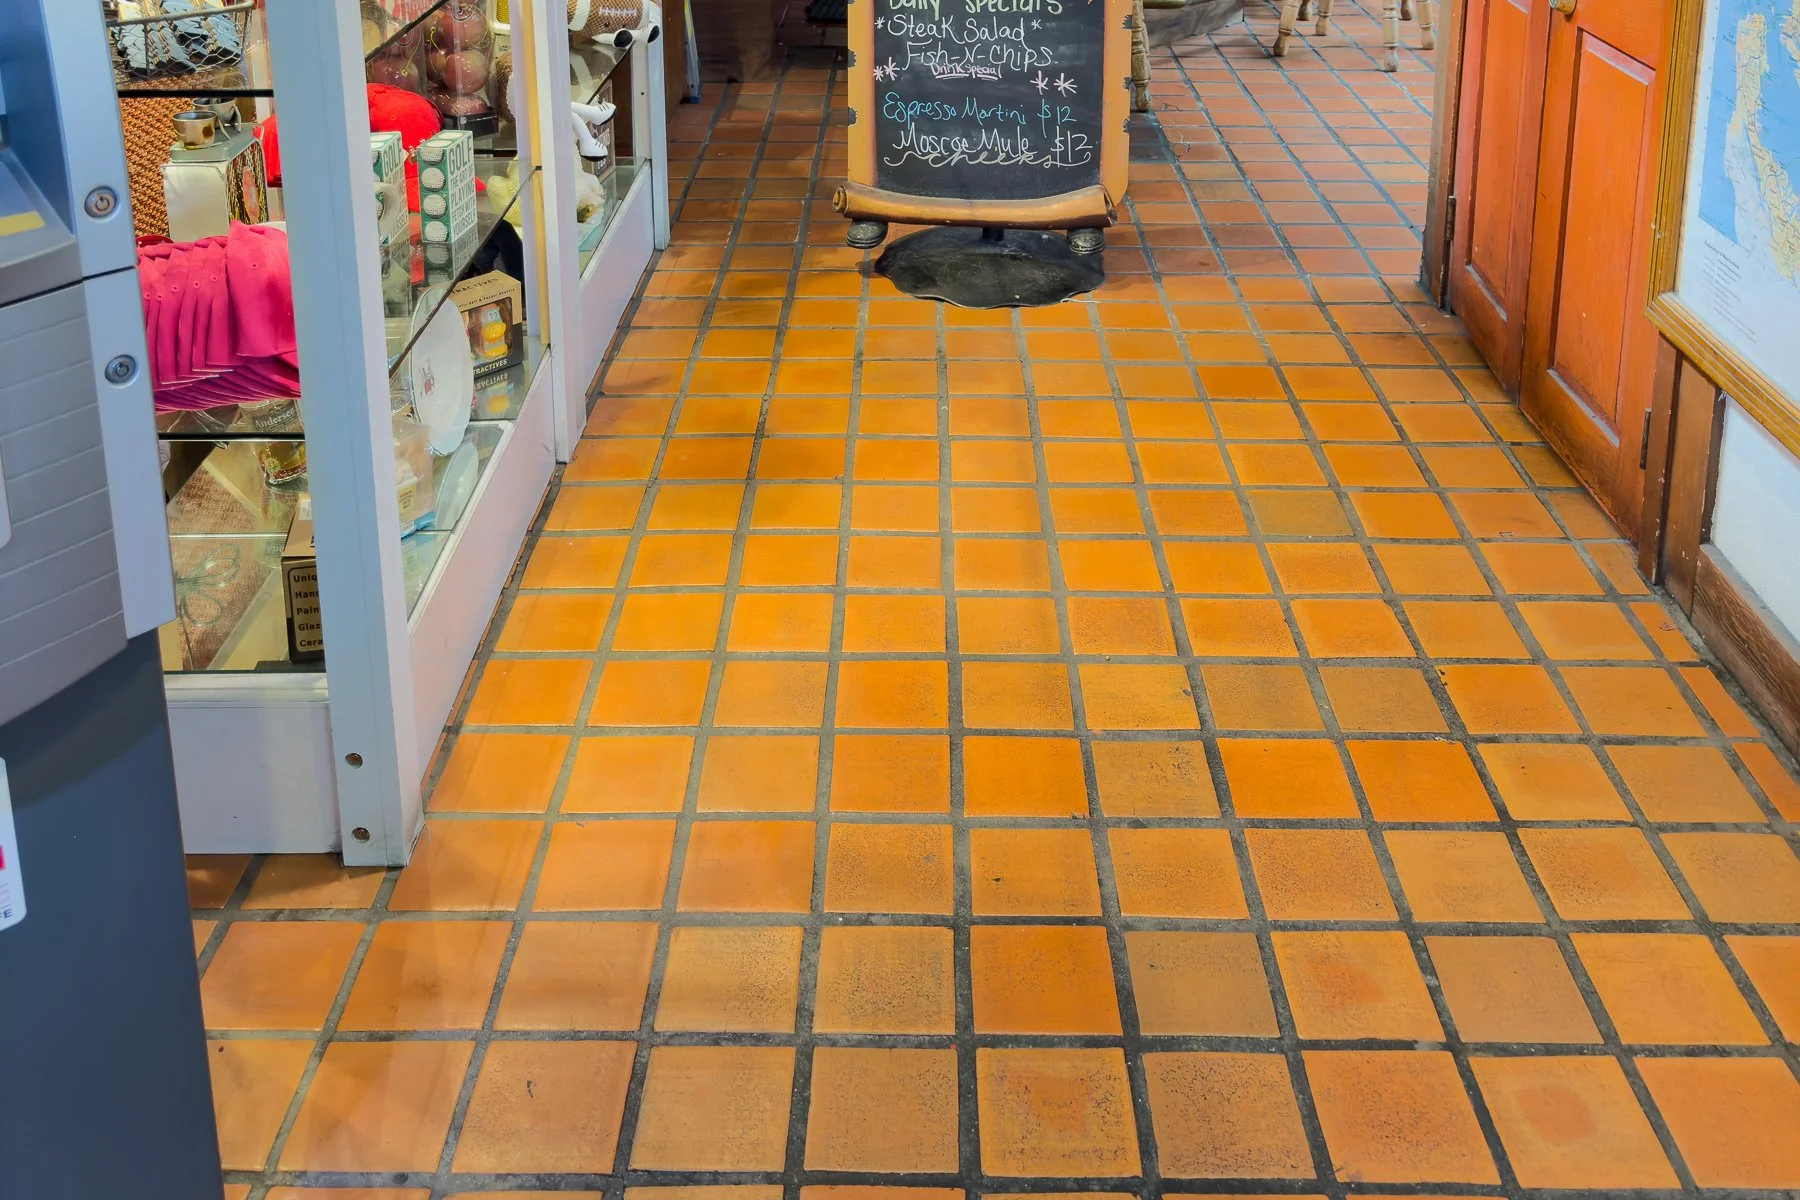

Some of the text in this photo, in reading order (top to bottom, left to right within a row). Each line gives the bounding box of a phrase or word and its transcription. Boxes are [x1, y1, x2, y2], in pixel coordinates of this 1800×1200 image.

[963, 17, 1030, 50] Salad
[961, 97, 1027, 126] Martini
[383, 138, 402, 178] GOLF
[449, 135, 473, 176] GOLF
[969, 126, 1038, 158] Mule
[1050, 126, 1093, 168] $12
[450, 163, 474, 187] THE ART OF
[450, 178, 475, 209] PLAYING
[255, 407, 296, 429] Andersen
[293, 574, 318, 583] Uniq
[296, 607, 320, 616] Pain
[298, 623, 321, 631] Glaz
[299, 639, 323, 648] Cera
